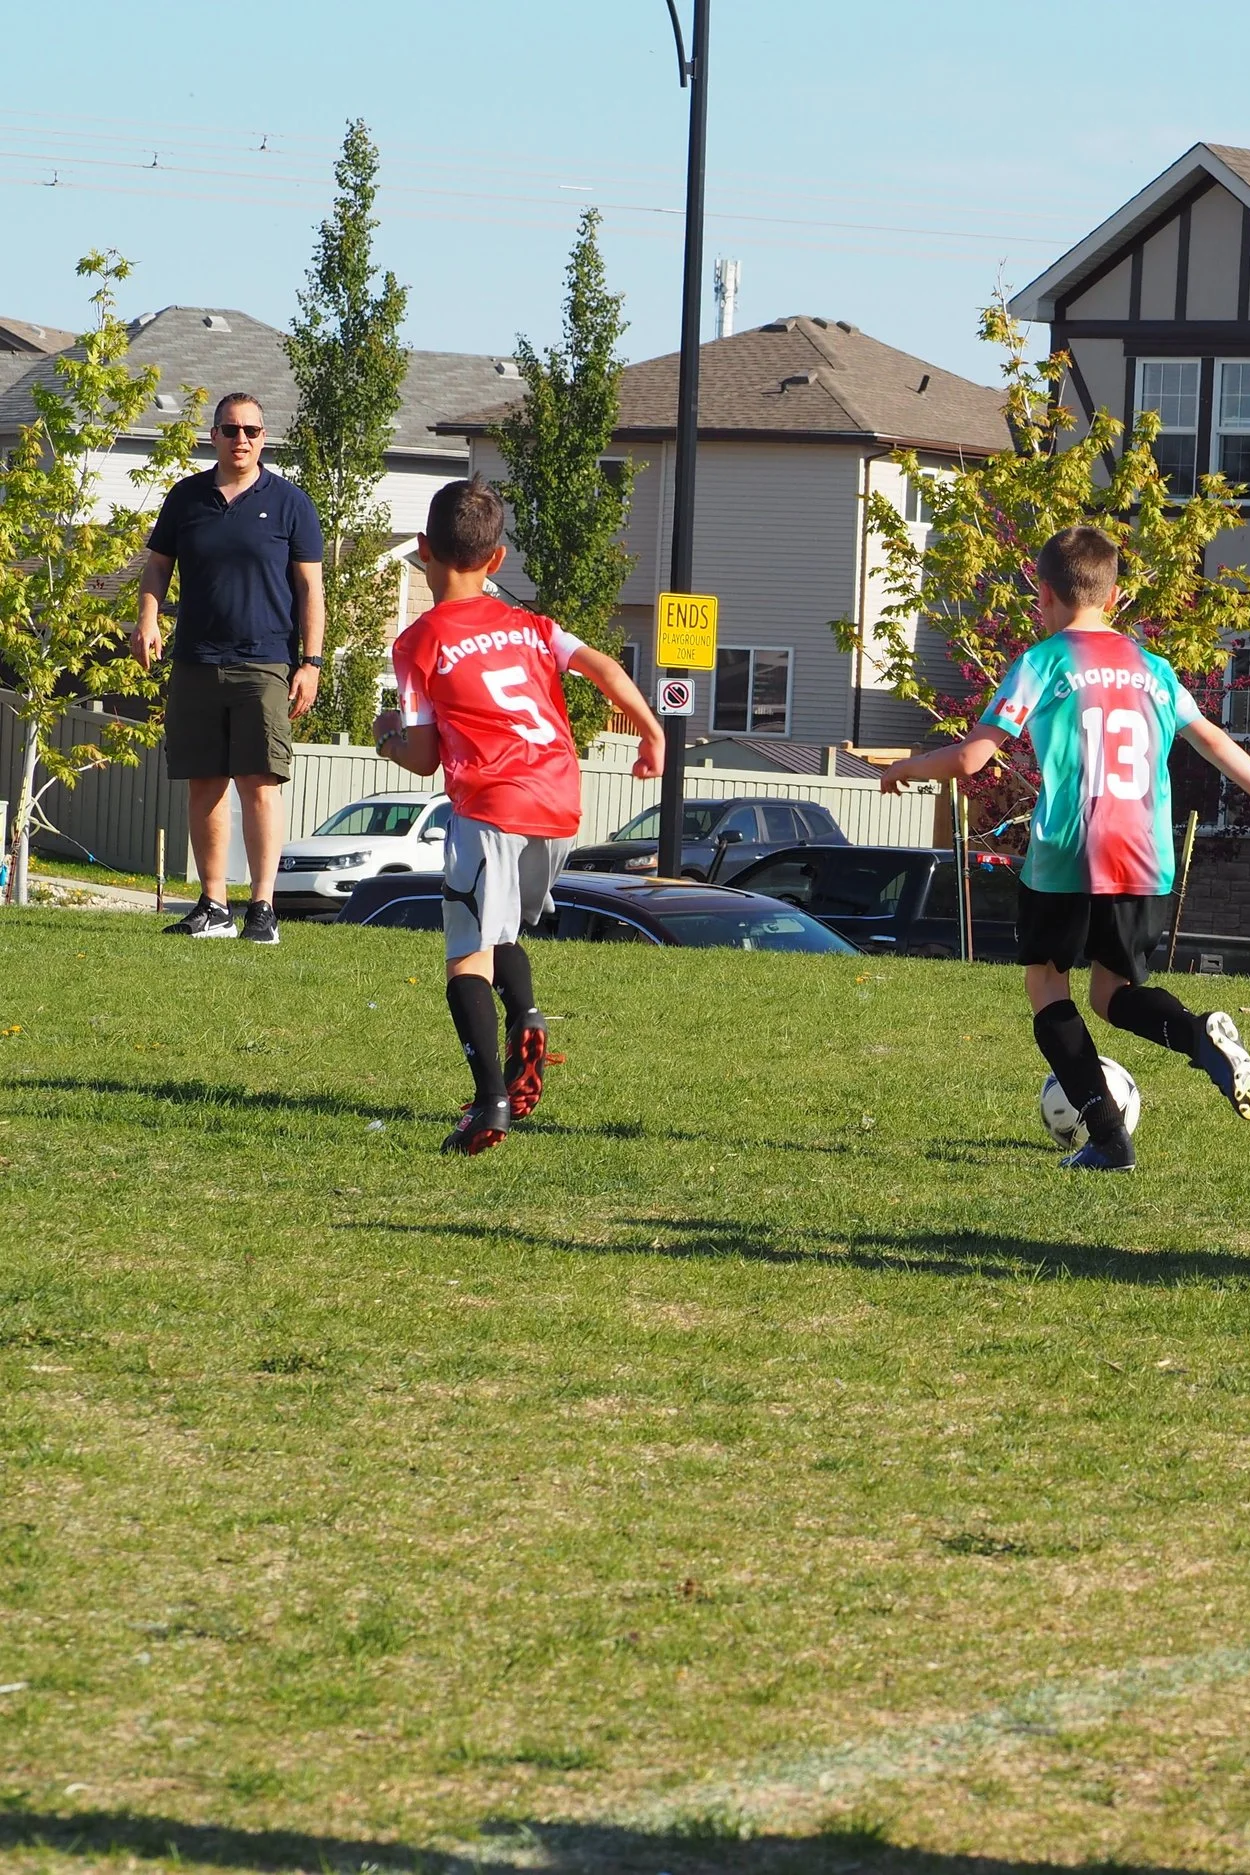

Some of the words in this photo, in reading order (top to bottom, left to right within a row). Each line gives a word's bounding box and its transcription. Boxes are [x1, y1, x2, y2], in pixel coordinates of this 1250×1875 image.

[667, 602, 709, 630] ENDS
[662, 632, 712, 647] PLAYGROUND
[676, 647, 696, 661] ZONE
[480, 664, 558, 746] 5
[1081, 706, 1151, 801] 13
